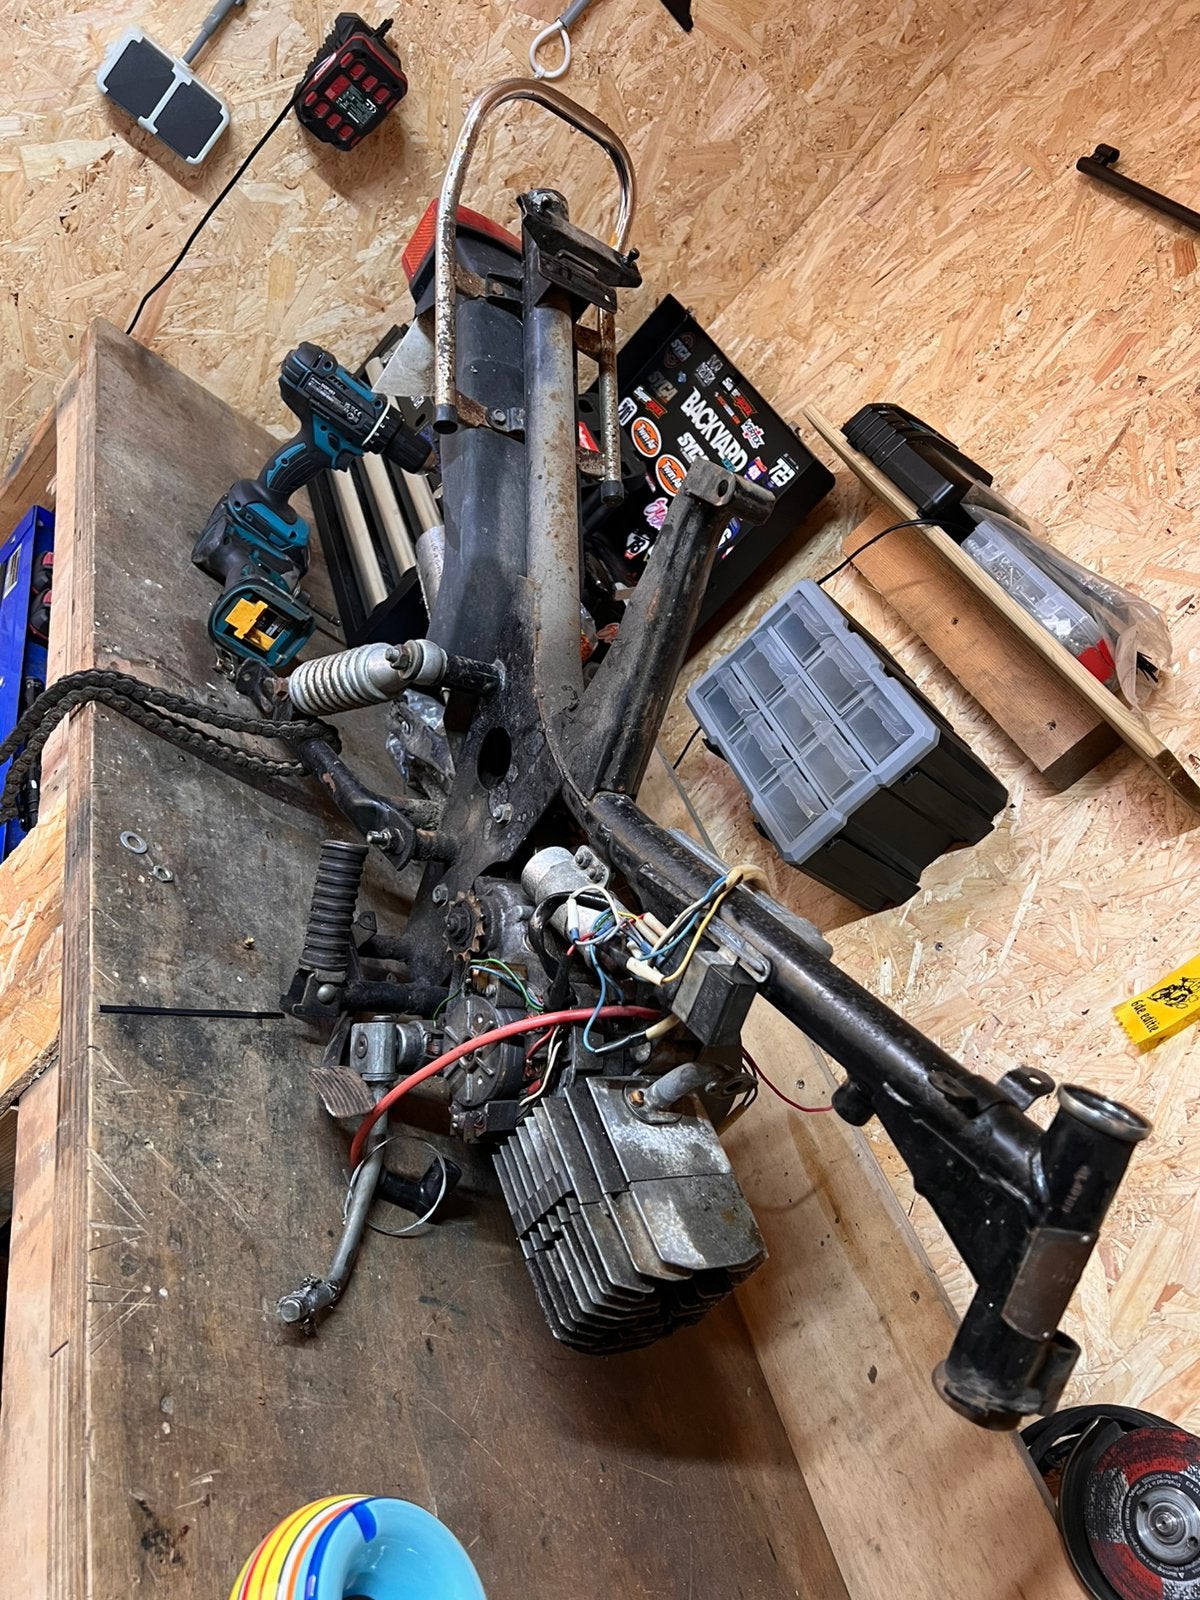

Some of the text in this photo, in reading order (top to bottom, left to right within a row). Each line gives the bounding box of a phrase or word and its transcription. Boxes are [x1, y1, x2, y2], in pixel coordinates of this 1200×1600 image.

[671, 338, 692, 361] SYCA
[648, 371, 678, 402] SYCA
[637, 423, 650, 443] Twin
[681, 386, 748, 472] BACKYARD
[743, 420, 763, 446] VERTEX
[677, 432, 709, 461] SYC
[661, 460, 676, 483] Twin
[768, 458, 795, 487] 723
[626, 535, 646, 553] 78
